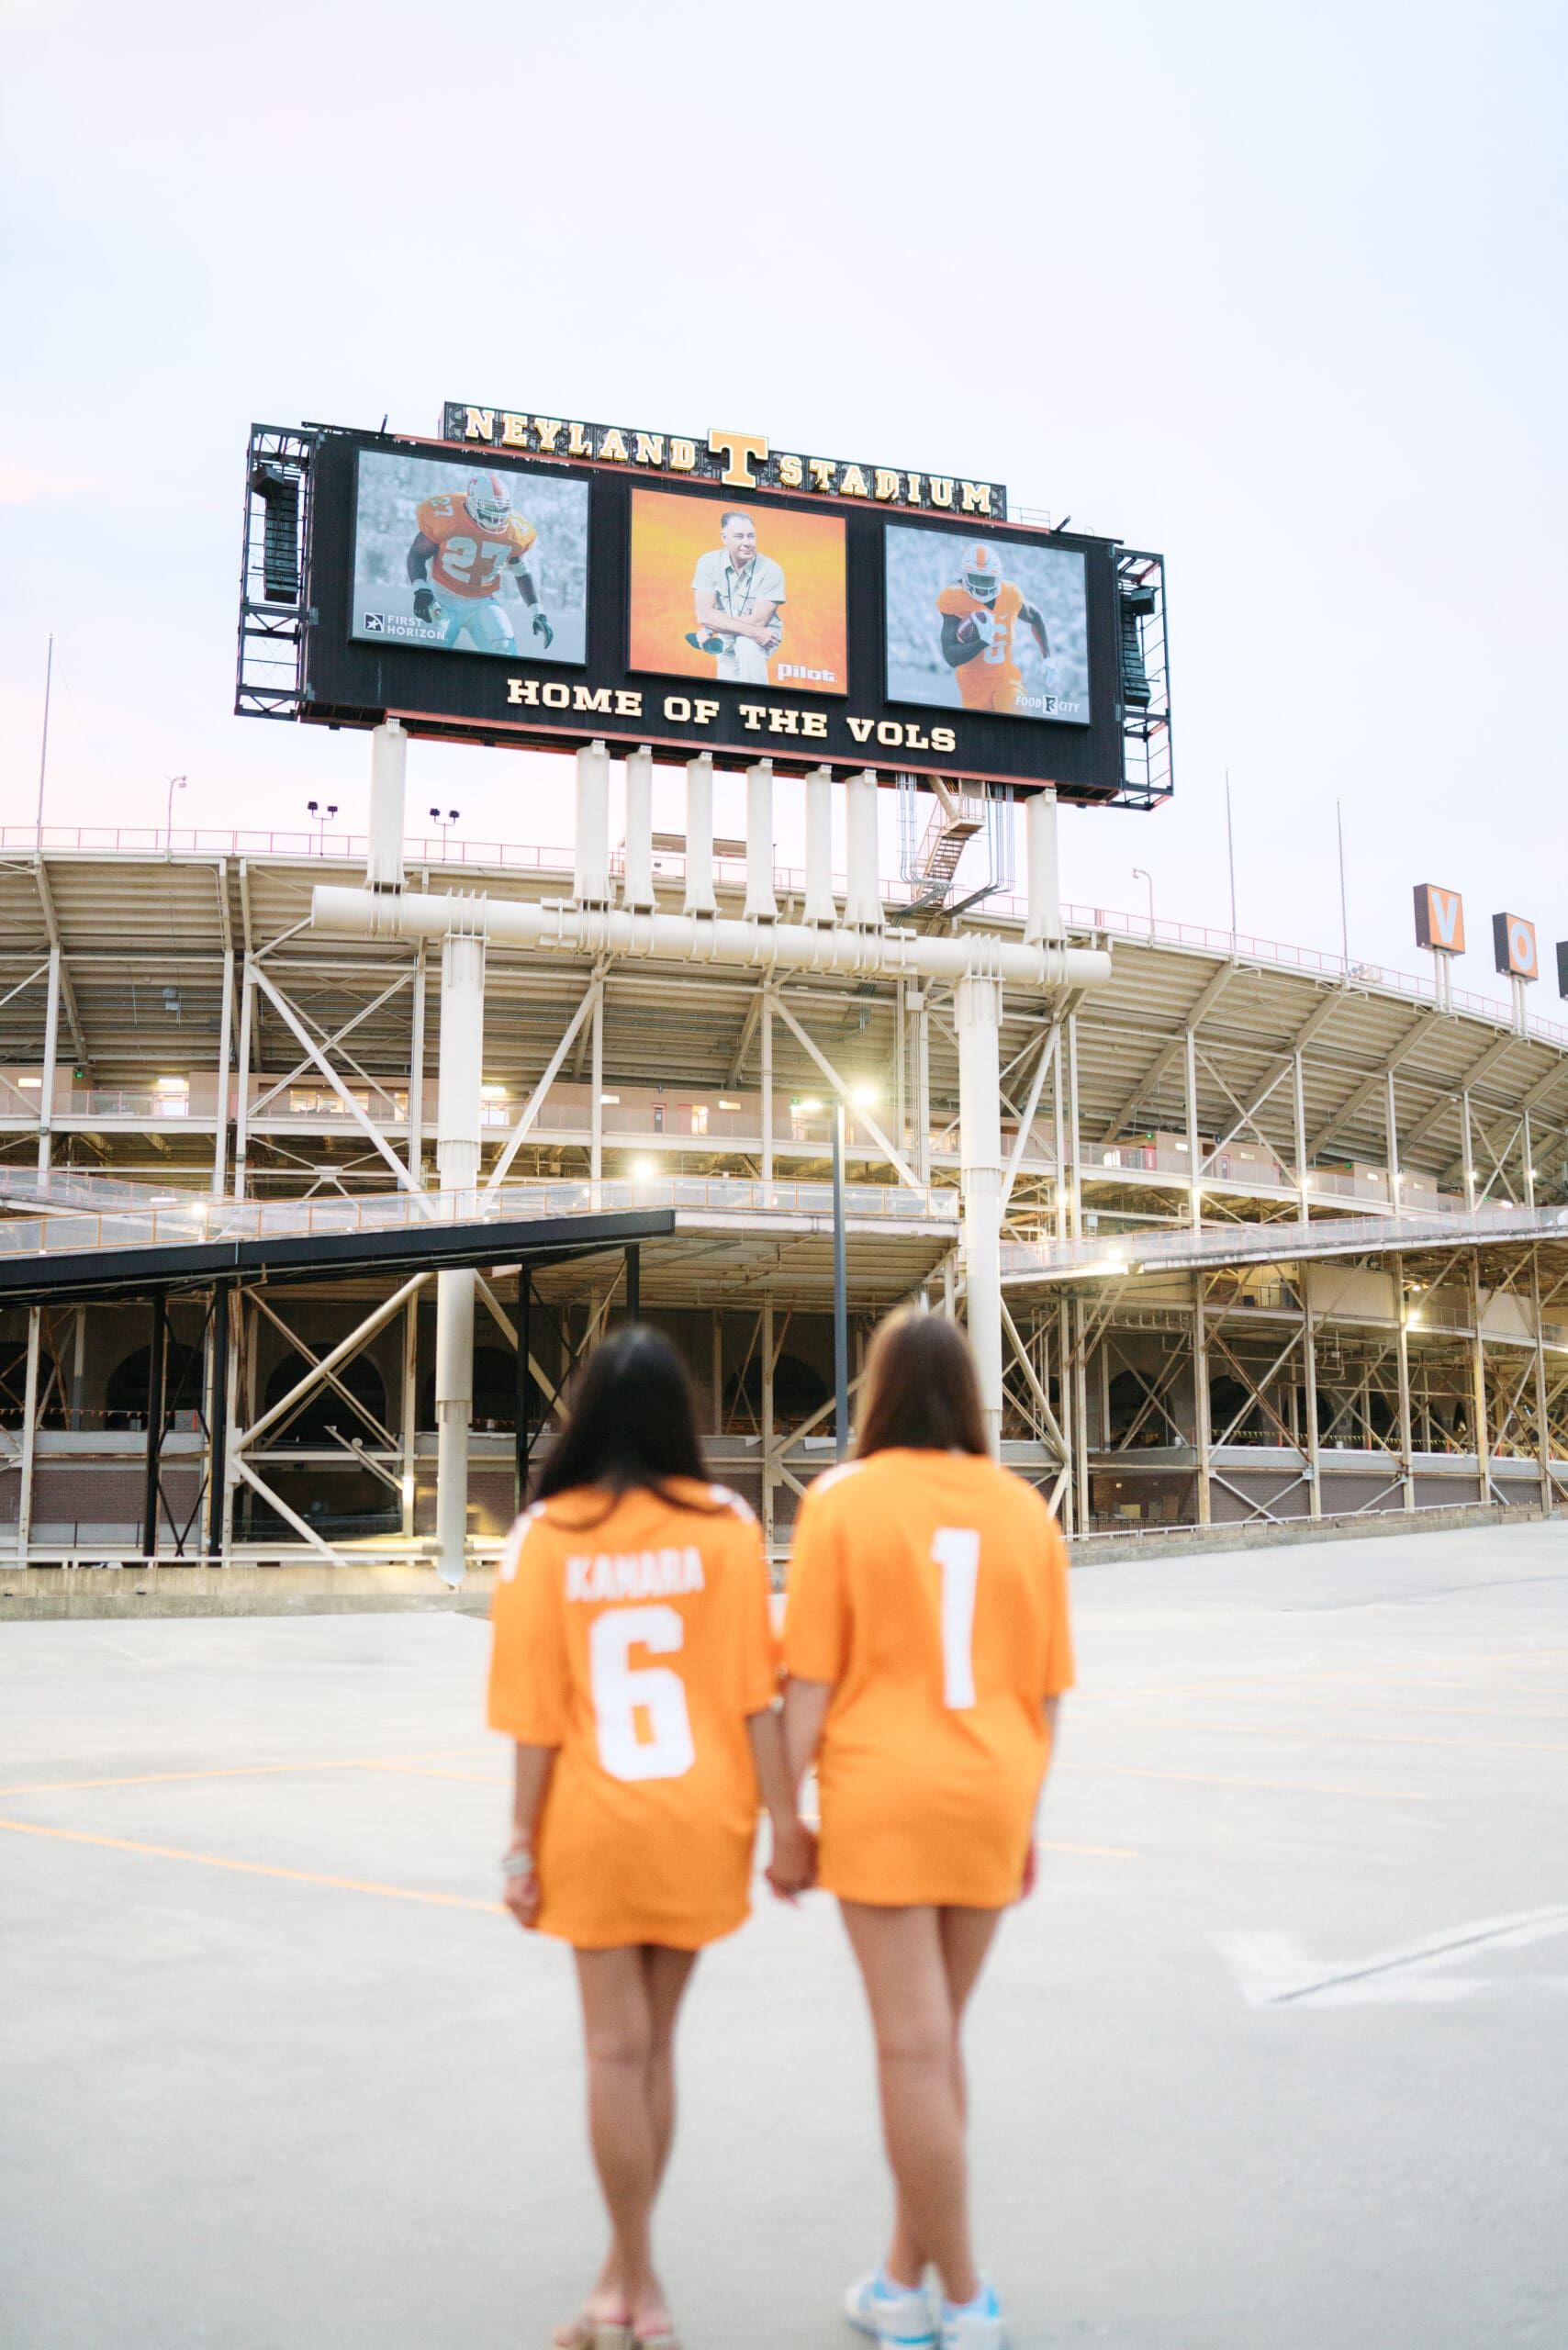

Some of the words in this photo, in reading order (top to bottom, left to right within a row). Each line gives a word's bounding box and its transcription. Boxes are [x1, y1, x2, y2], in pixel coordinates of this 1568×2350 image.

[465, 407, 695, 471] NEYLAND
[708, 428, 768, 488] T
[779, 454, 991, 513] STADIUM
[442, 536, 512, 583] 27
[386, 614, 423, 628] FIRST
[386, 625, 445, 640] HORIZON
[507, 678, 643, 717] HOME
[664, 696, 720, 724] OF
[739, 704, 827, 738] THE
[846, 717, 956, 752] VOLS
[1015, 695, 1042, 708] FOOD
[1059, 701, 1080, 713] CITY
[931, 1528, 980, 1710] 1
[589, 1606, 695, 1781] 6
